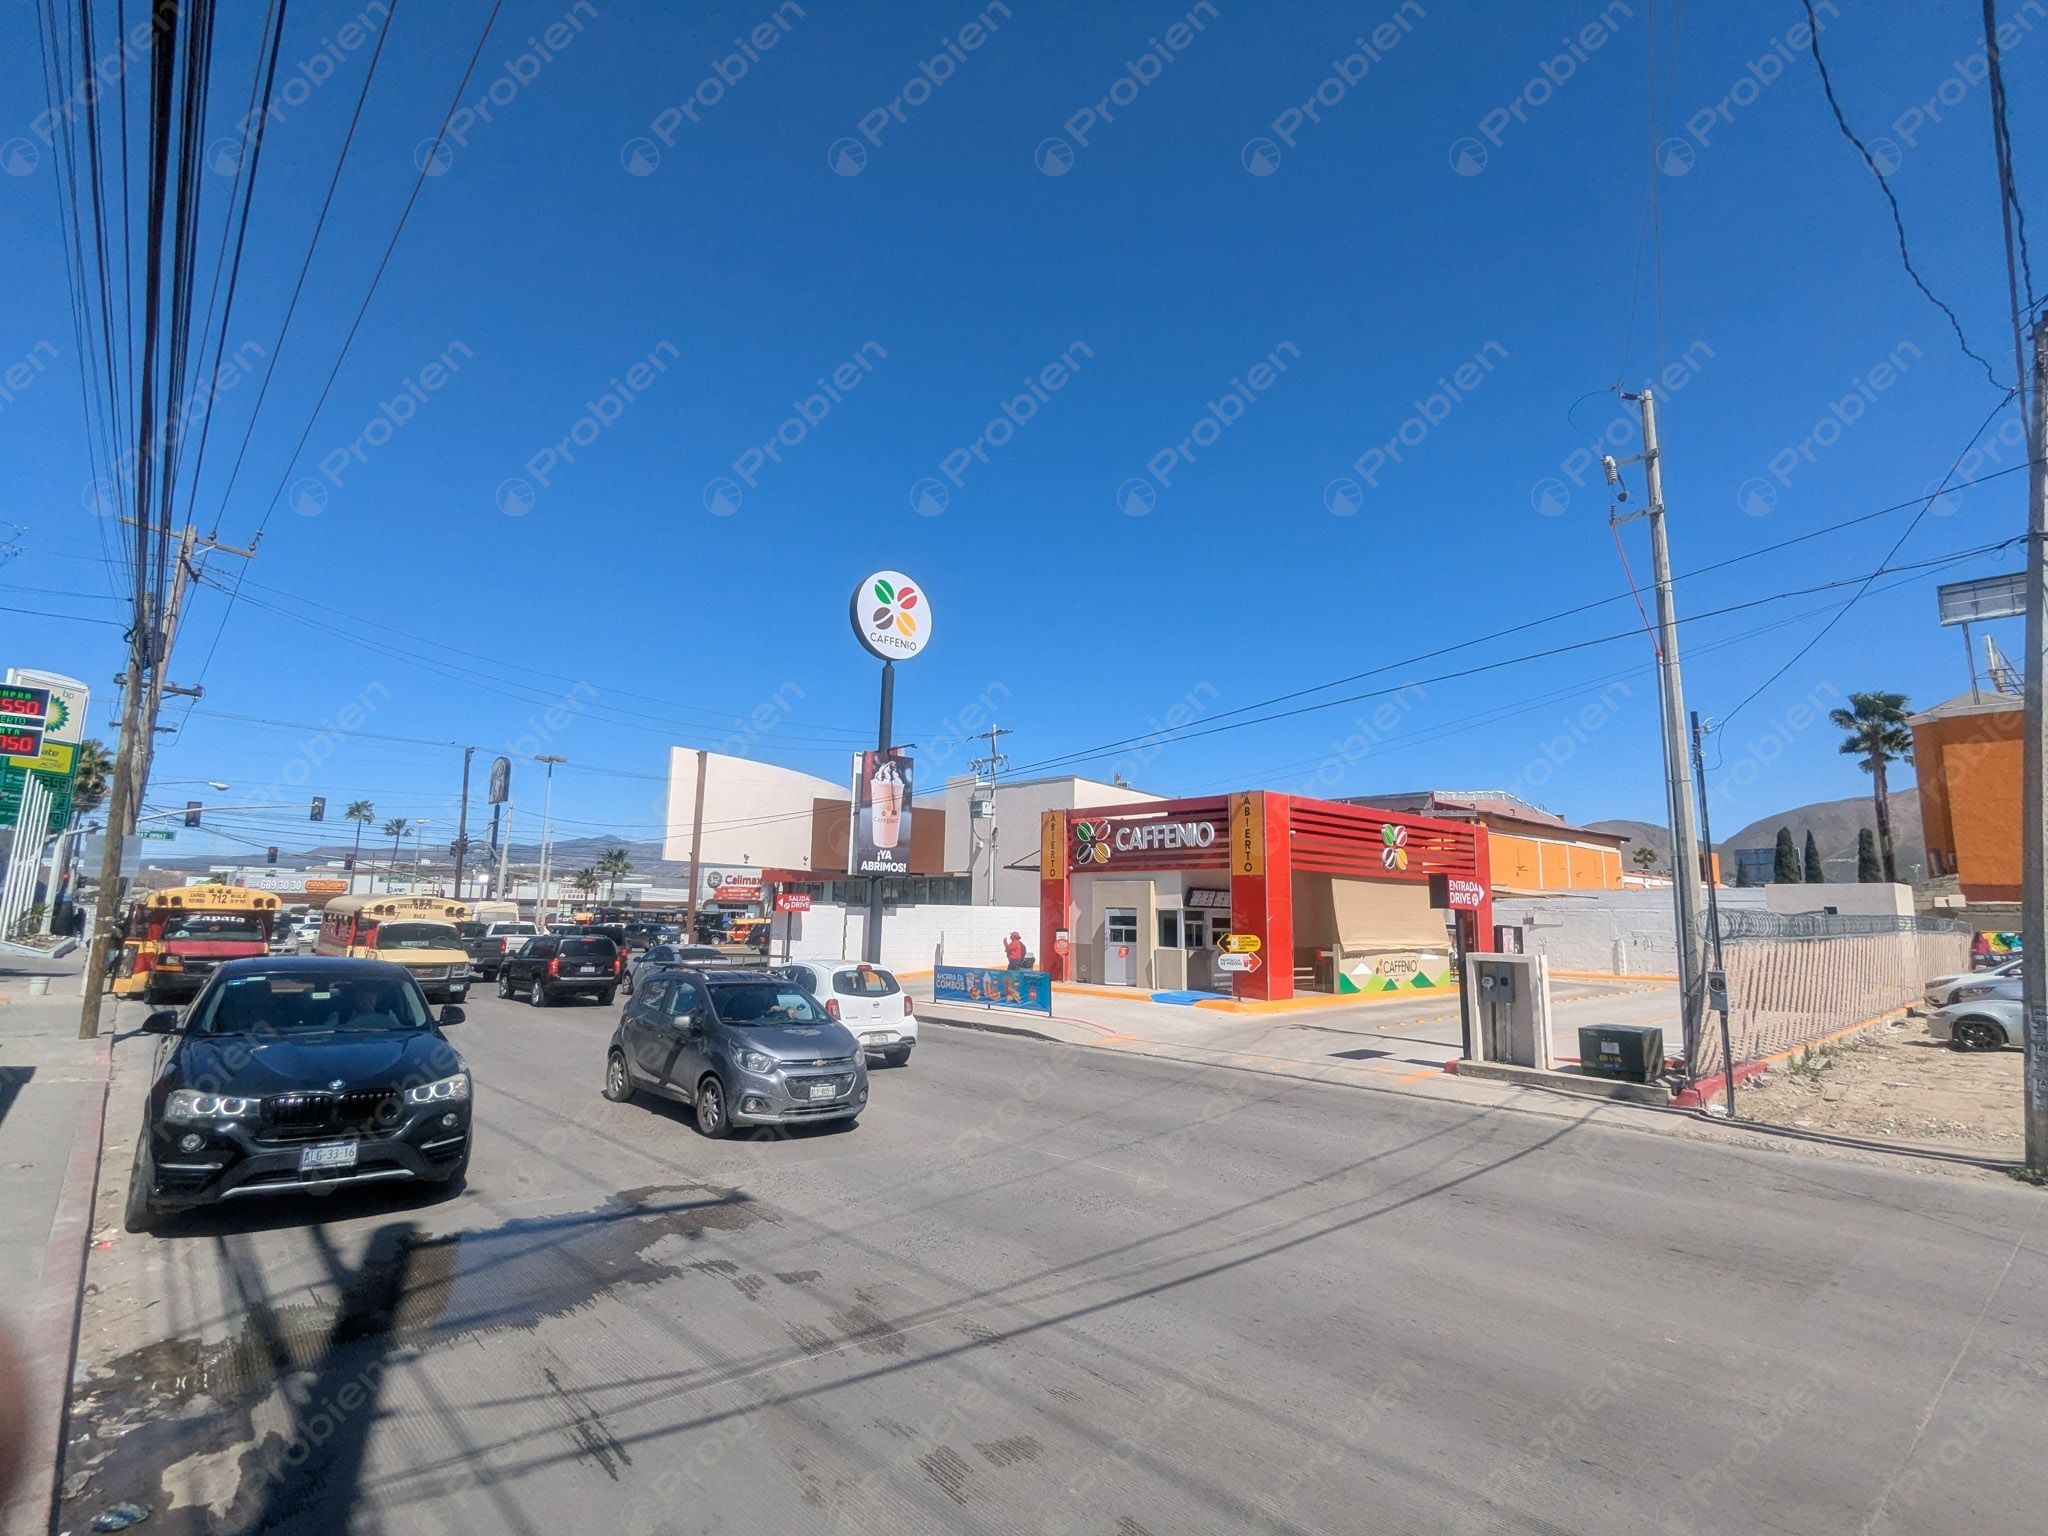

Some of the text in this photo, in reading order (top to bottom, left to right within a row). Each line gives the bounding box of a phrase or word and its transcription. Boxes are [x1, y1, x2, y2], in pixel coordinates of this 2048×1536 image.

[870, 632, 917, 651] CAFFENIO
[62, 690, 75, 700] bp
[1115, 821, 1215, 851] CAFFENIO
[1242, 796, 1253, 873] ABIERTO
[1049, 813, 1057, 878] ABIERTO
[877, 850, 892, 861] ¡YA
[861, 861, 906, 873] ABRIMOS!
[1449, 880, 1479, 892] ENTRADA
[211, 893, 228, 904] 712
[1450, 892, 1471, 904] DRIVE
[790, 901, 810, 909] DRIVE
[184, 914, 245, 923] Zapata
[1384, 960, 1417, 974] CAFFENIO
[936, 980, 964, 990] COMBOS
